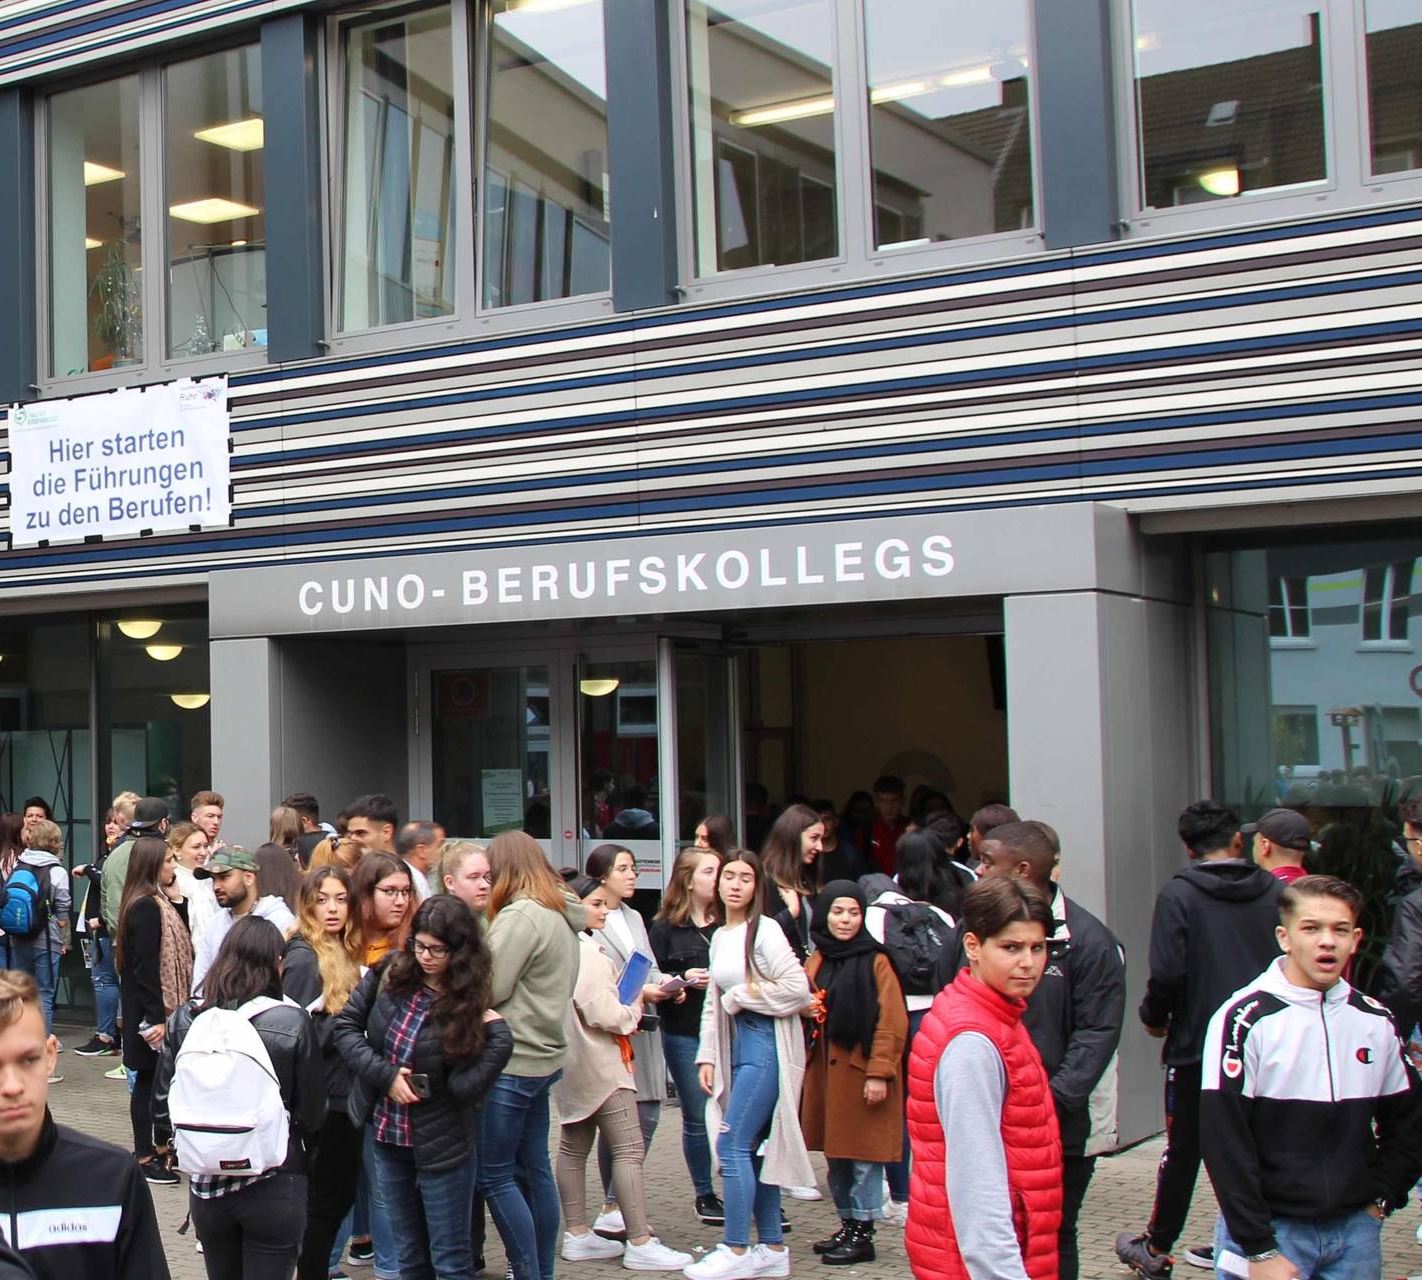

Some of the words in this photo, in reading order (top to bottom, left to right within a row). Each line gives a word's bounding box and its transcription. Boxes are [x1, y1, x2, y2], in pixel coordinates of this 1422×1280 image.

[49, 439, 94, 463] Hier
[101, 428, 185, 457] starten
[33, 473, 67, 497] die
[74, 460, 204, 493] Führungen
[26, 511, 51, 529] zu
[58, 502, 100, 526] den
[108, 487, 212, 521] Berufen!
[461, 534, 956, 607] BERUFSKOLLEGS
